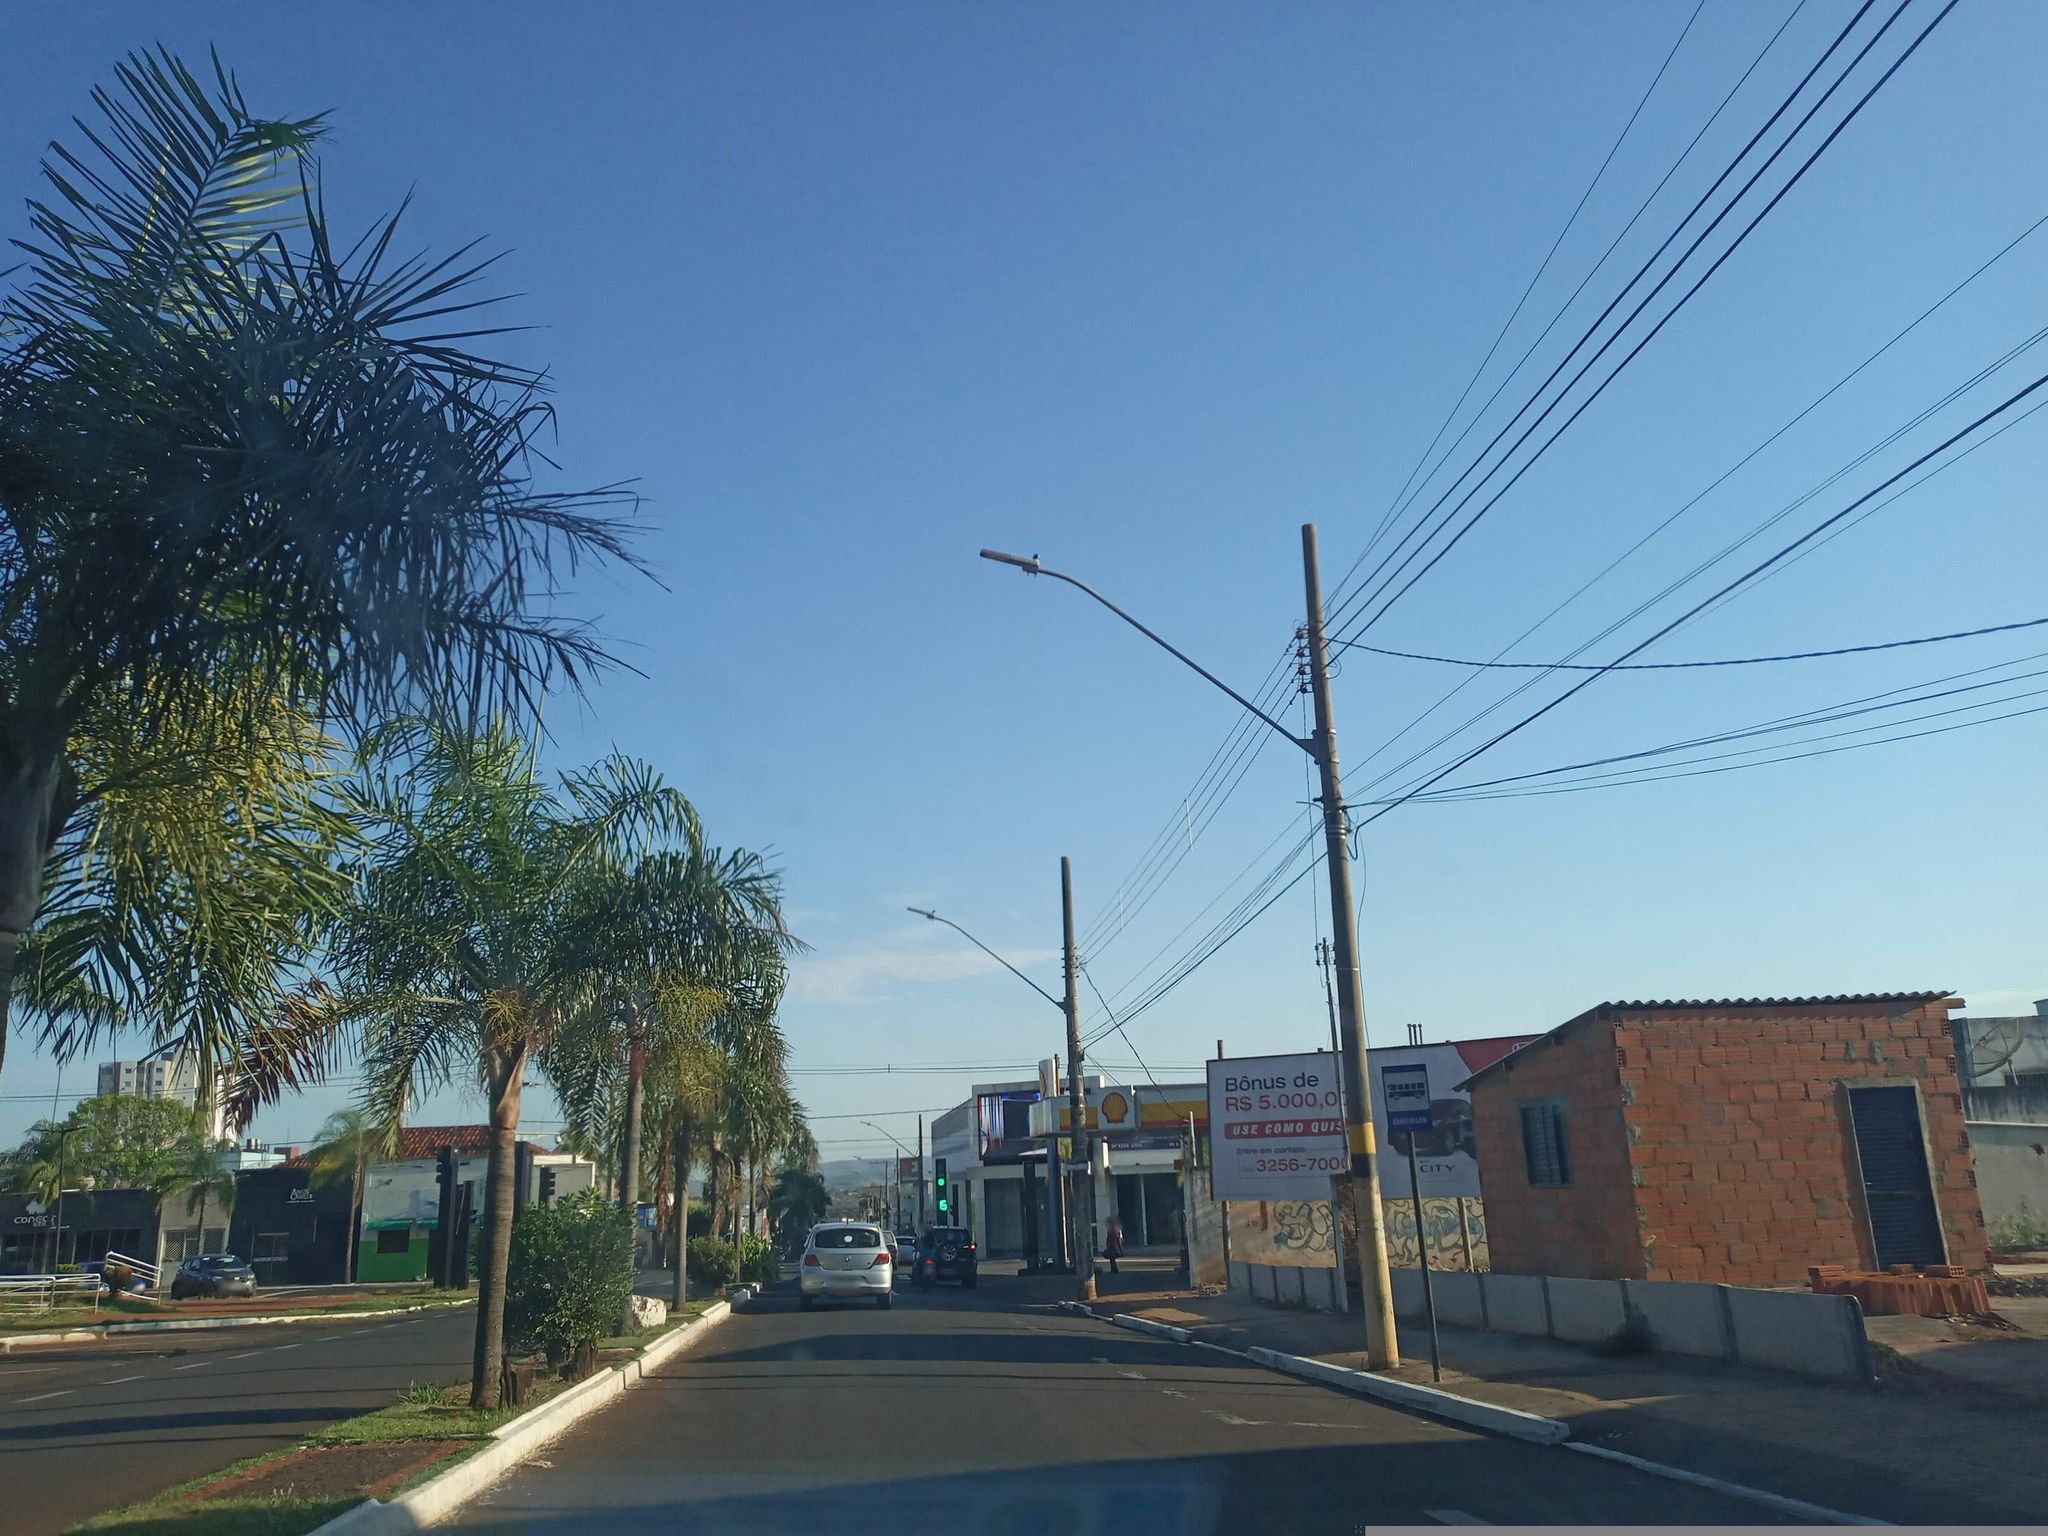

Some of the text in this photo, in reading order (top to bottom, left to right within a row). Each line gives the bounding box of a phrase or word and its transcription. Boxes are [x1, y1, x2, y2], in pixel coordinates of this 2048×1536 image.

[1225, 1072, 1320, 1092] Bônus de
[1225, 1096, 1252, 1112] R$
[1232, 1124, 1259, 1136] USE
[1264, 1122, 1304, 1134] COMO
[1420, 1164, 1455, 1173] CITY
[939, 1199, 948, 1211] 6
